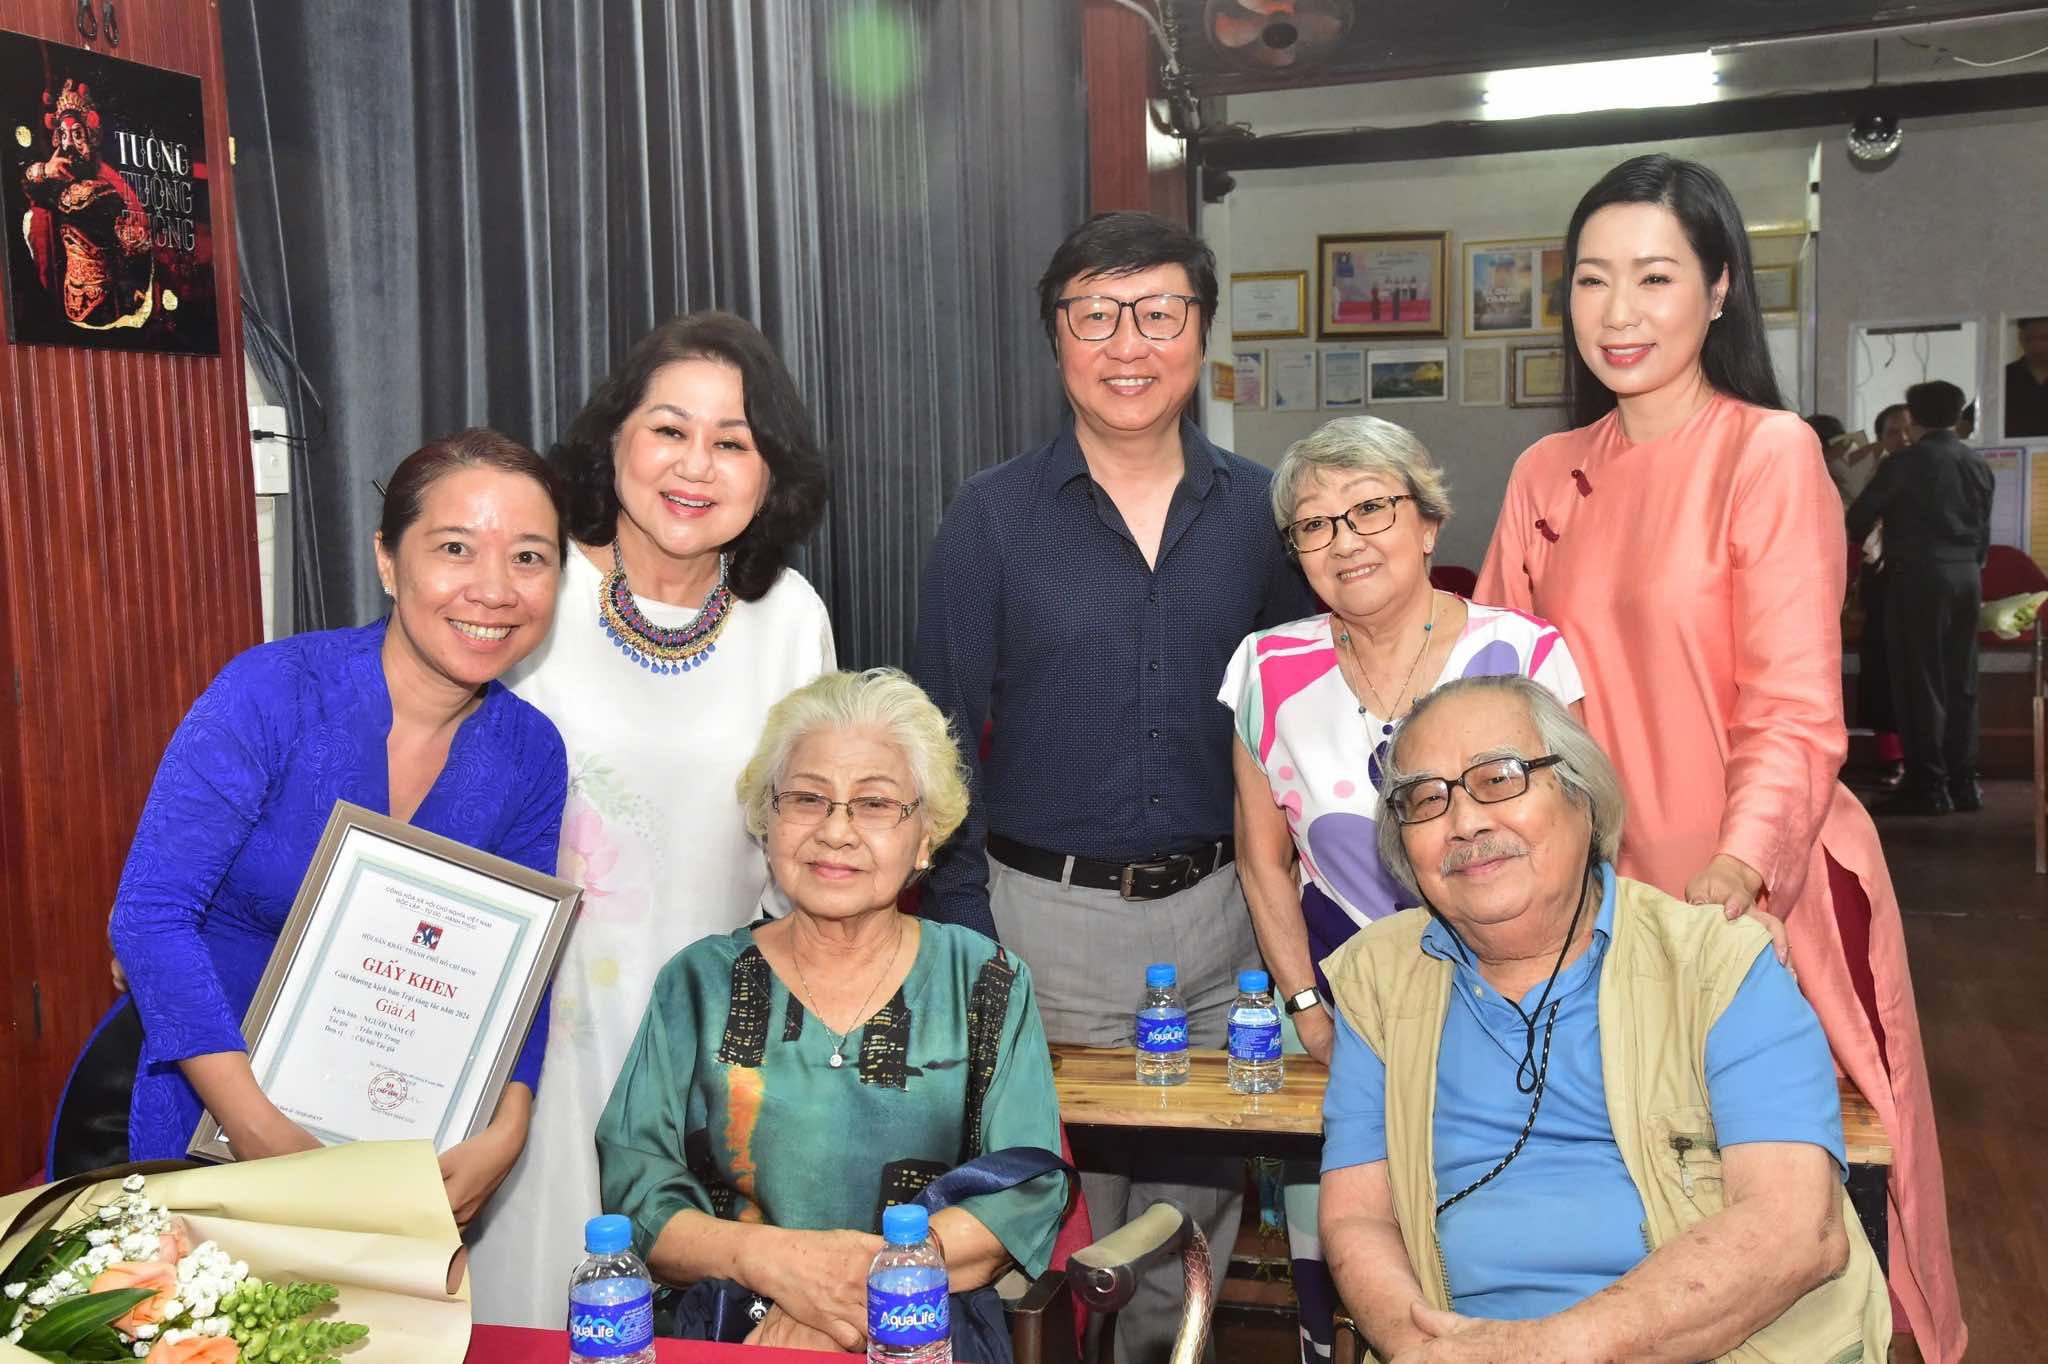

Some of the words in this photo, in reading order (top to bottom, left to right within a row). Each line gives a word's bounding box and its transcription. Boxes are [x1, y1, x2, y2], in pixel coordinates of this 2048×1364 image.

[362, 957, 405, 980] GIẤY
[407, 972, 457, 998] KHEN
[375, 998, 404, 1017] Giải
[404, 1008, 415, 1021] A
[880, 1311, 936, 1328] AquaLife
[572, 1324, 615, 1338] quaLife
